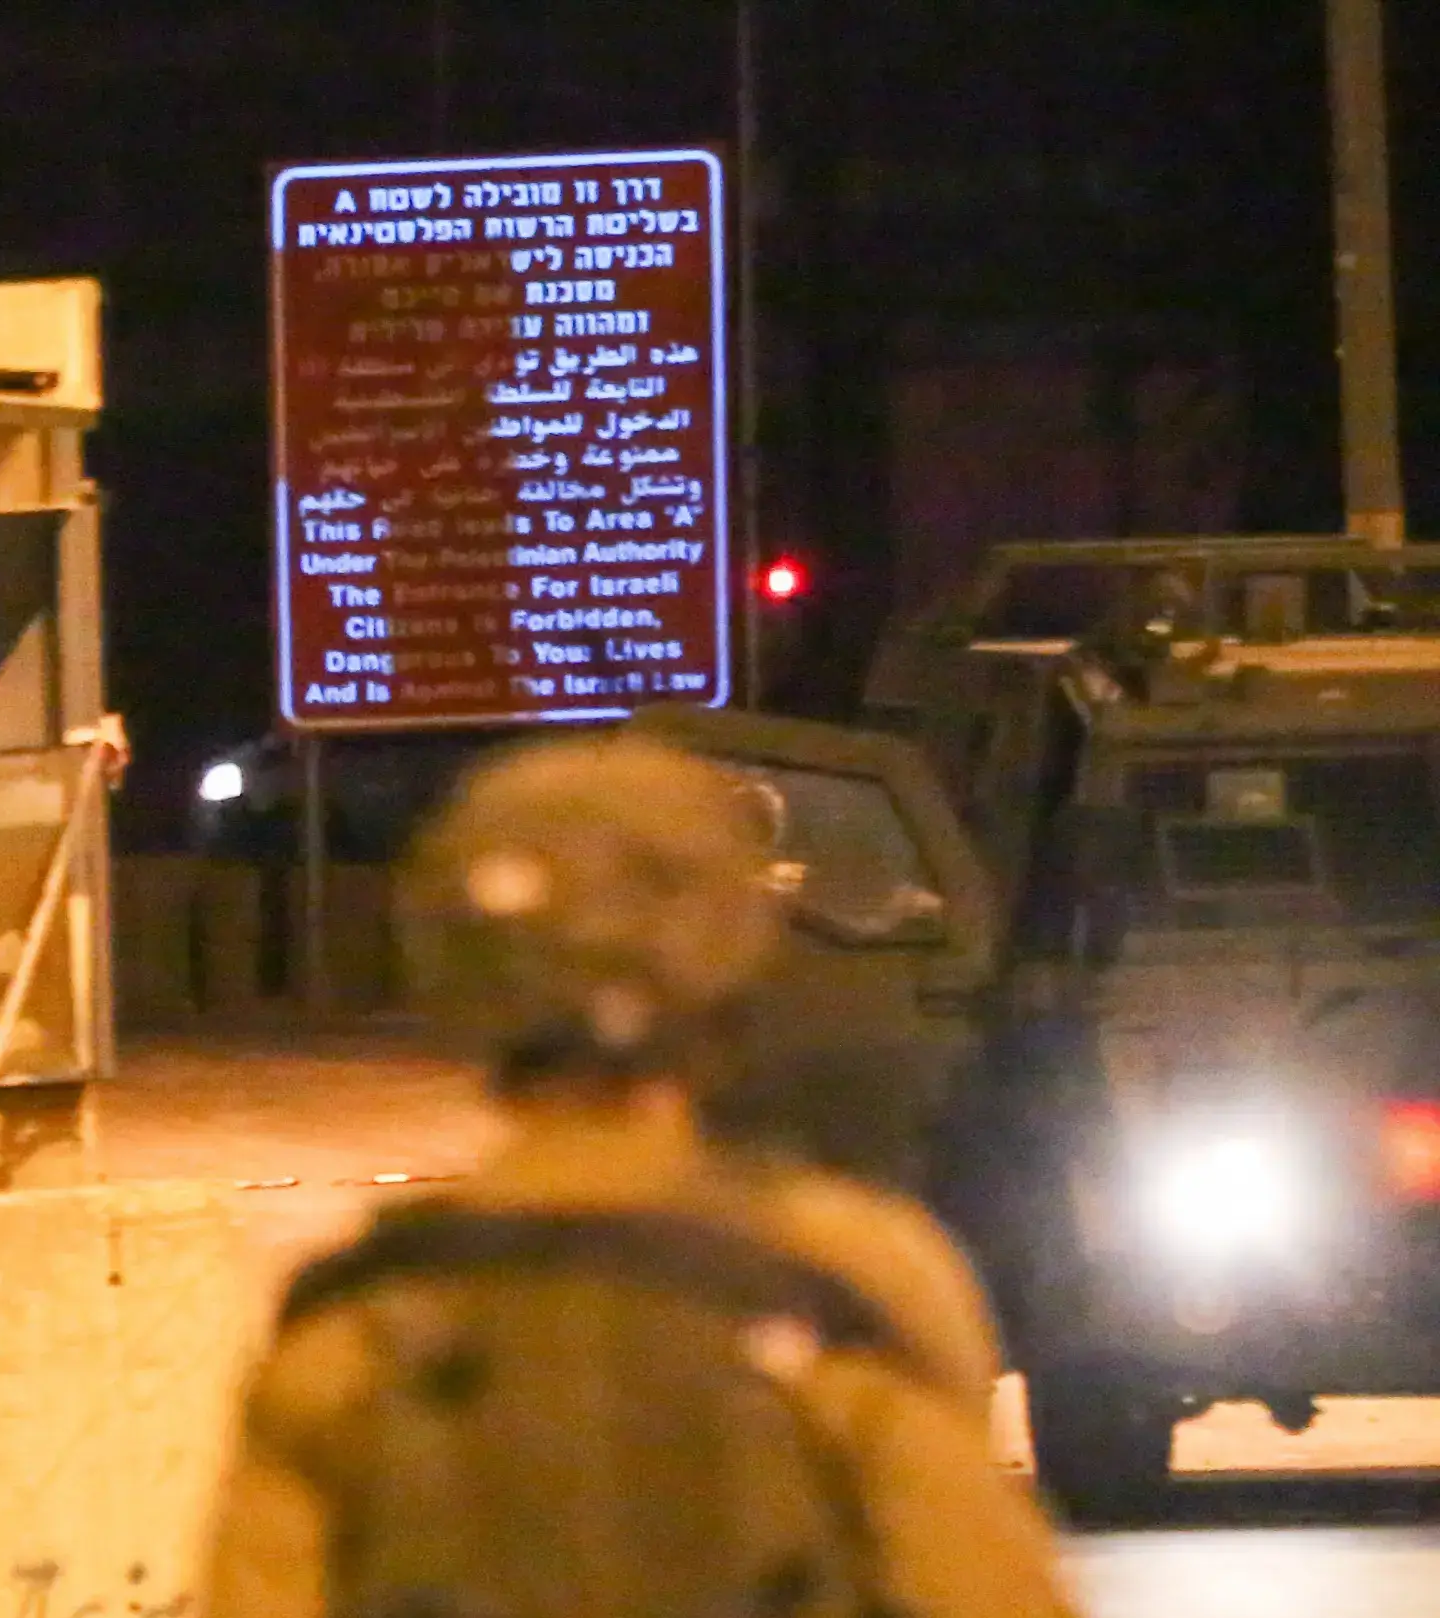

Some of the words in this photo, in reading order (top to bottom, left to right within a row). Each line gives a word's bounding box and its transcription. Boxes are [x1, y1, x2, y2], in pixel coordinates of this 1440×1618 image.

[334, 190, 357, 213] A
[611, 178, 662, 205] דרך
[303, 519, 362, 542] This
[544, 510, 575, 532] To
[586, 509, 654, 530] Area
[300, 552, 376, 575] Under
[582, 539, 704, 564] Authority
[329, 584, 381, 607] The
[531, 576, 580, 599] For
[589, 571, 679, 597] Israeli
[511, 607, 662, 632] Forbidden,
[604, 637, 682, 661] Lives
[305, 681, 358, 703] And
[366, 681, 390, 702] Is
